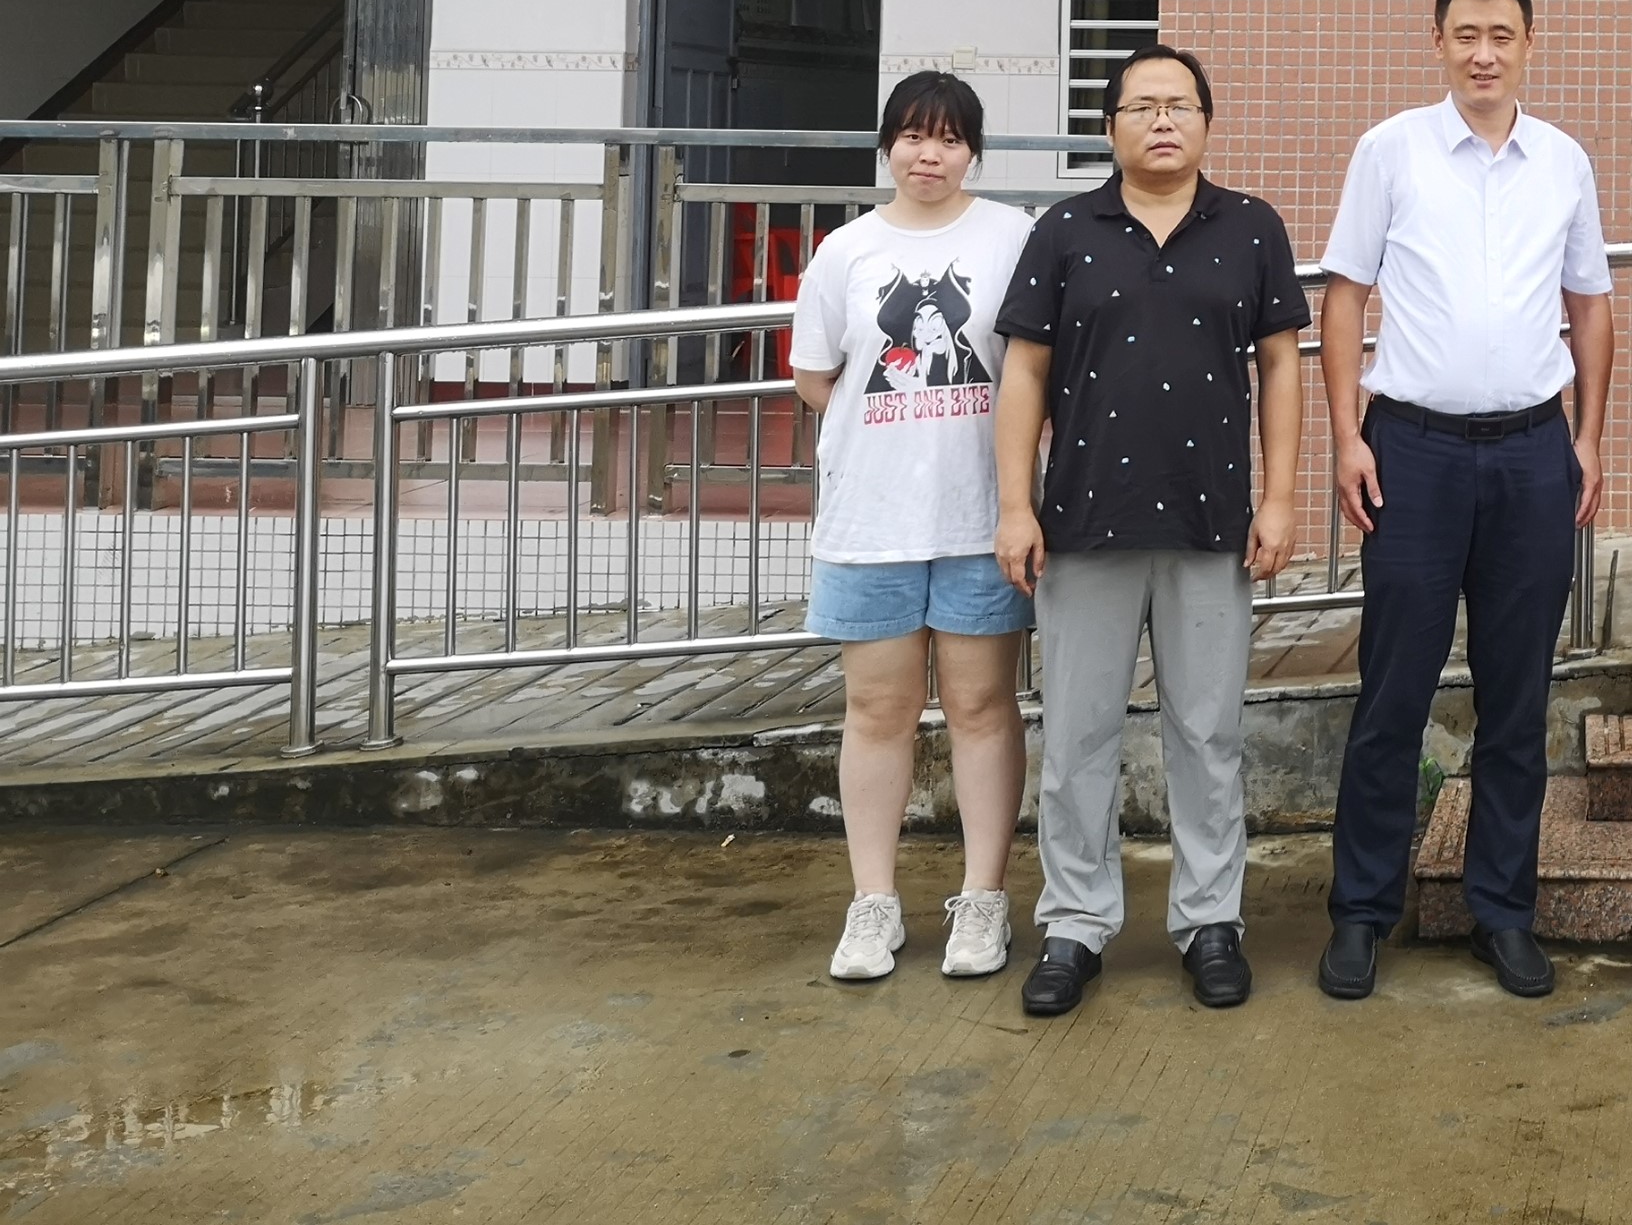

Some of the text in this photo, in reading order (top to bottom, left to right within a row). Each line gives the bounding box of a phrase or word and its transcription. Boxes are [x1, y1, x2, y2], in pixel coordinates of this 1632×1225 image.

[864, 385, 990, 425] JUST ONE BITE
